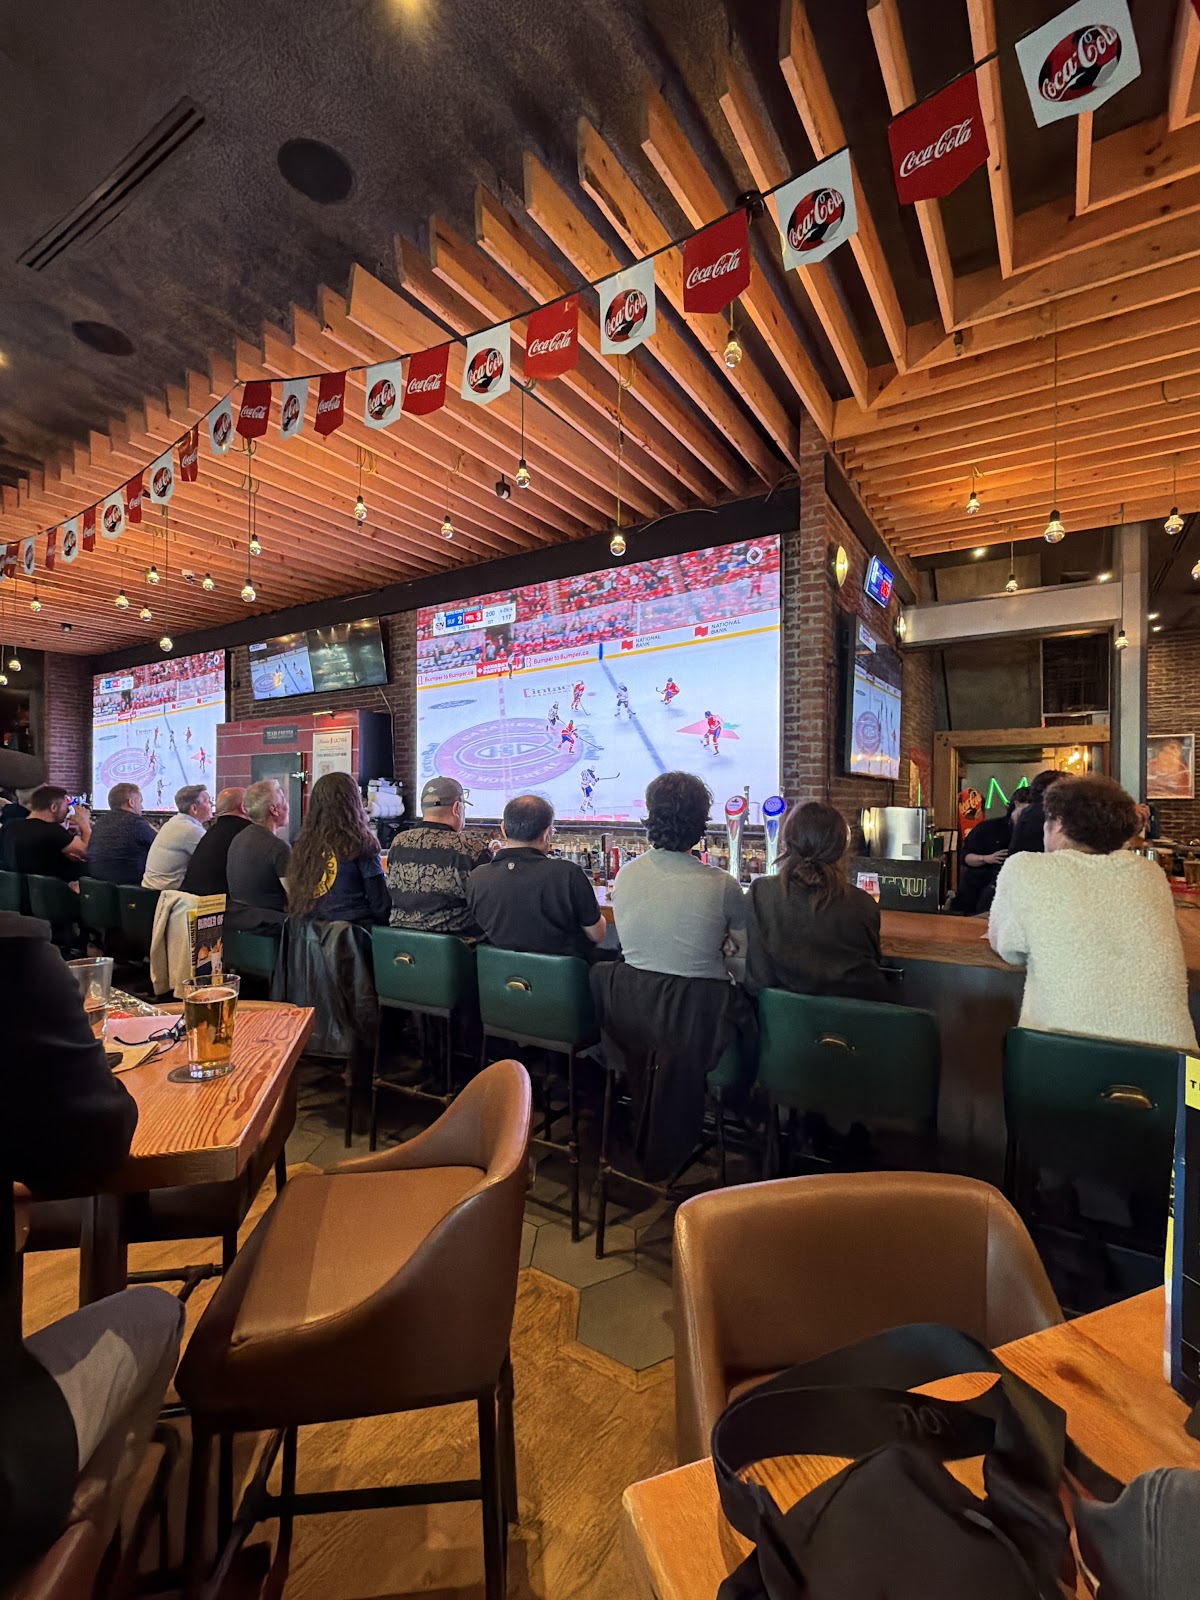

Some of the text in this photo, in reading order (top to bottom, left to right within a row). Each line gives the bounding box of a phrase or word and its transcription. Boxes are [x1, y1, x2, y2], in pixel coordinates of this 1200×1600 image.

[458, 616, 463, 624] 2
[476, 612, 482, 620] 3
[711, 619, 741, 629] NATIONAL
[710, 627, 728, 635] BANK
[635, 634, 661, 643] NATIONAL
[533, 656, 553, 665] Bumper
[424, 675, 443, 683] Bumper
